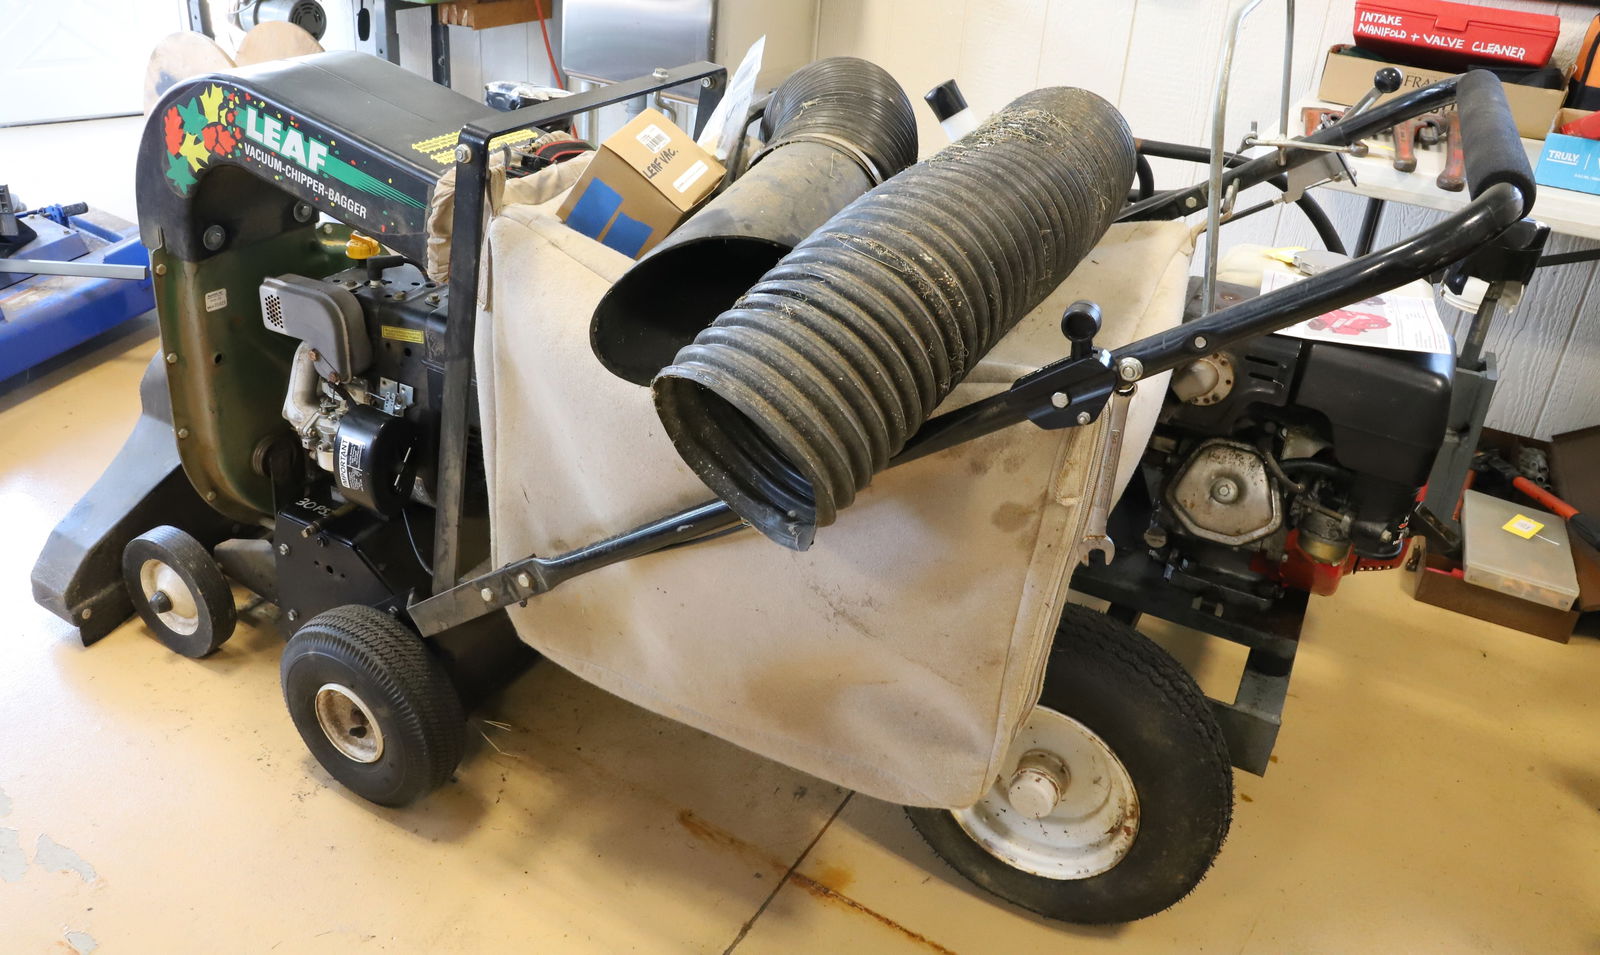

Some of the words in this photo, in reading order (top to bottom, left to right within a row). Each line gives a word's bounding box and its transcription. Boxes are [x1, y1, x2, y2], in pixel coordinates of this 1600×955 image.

[1360, 11, 1402, 26] INTAKE
[1357, 22, 1407, 39] MANIFOLD
[1423, 34, 1465, 50] VALVE
[1471, 41, 1526, 60] CLEANER
[245, 104, 328, 174] LEAF
[1547, 149, 1580, 164] TRULY
[243, 142, 367, 220] VACUUM-CHIPPER-BAGGER
[642, 157, 663, 180] LEAF
[659, 147, 679, 165] VAC.
[339, 439, 349, 488] IMPORTANT
[295, 497, 317, 509] 30
